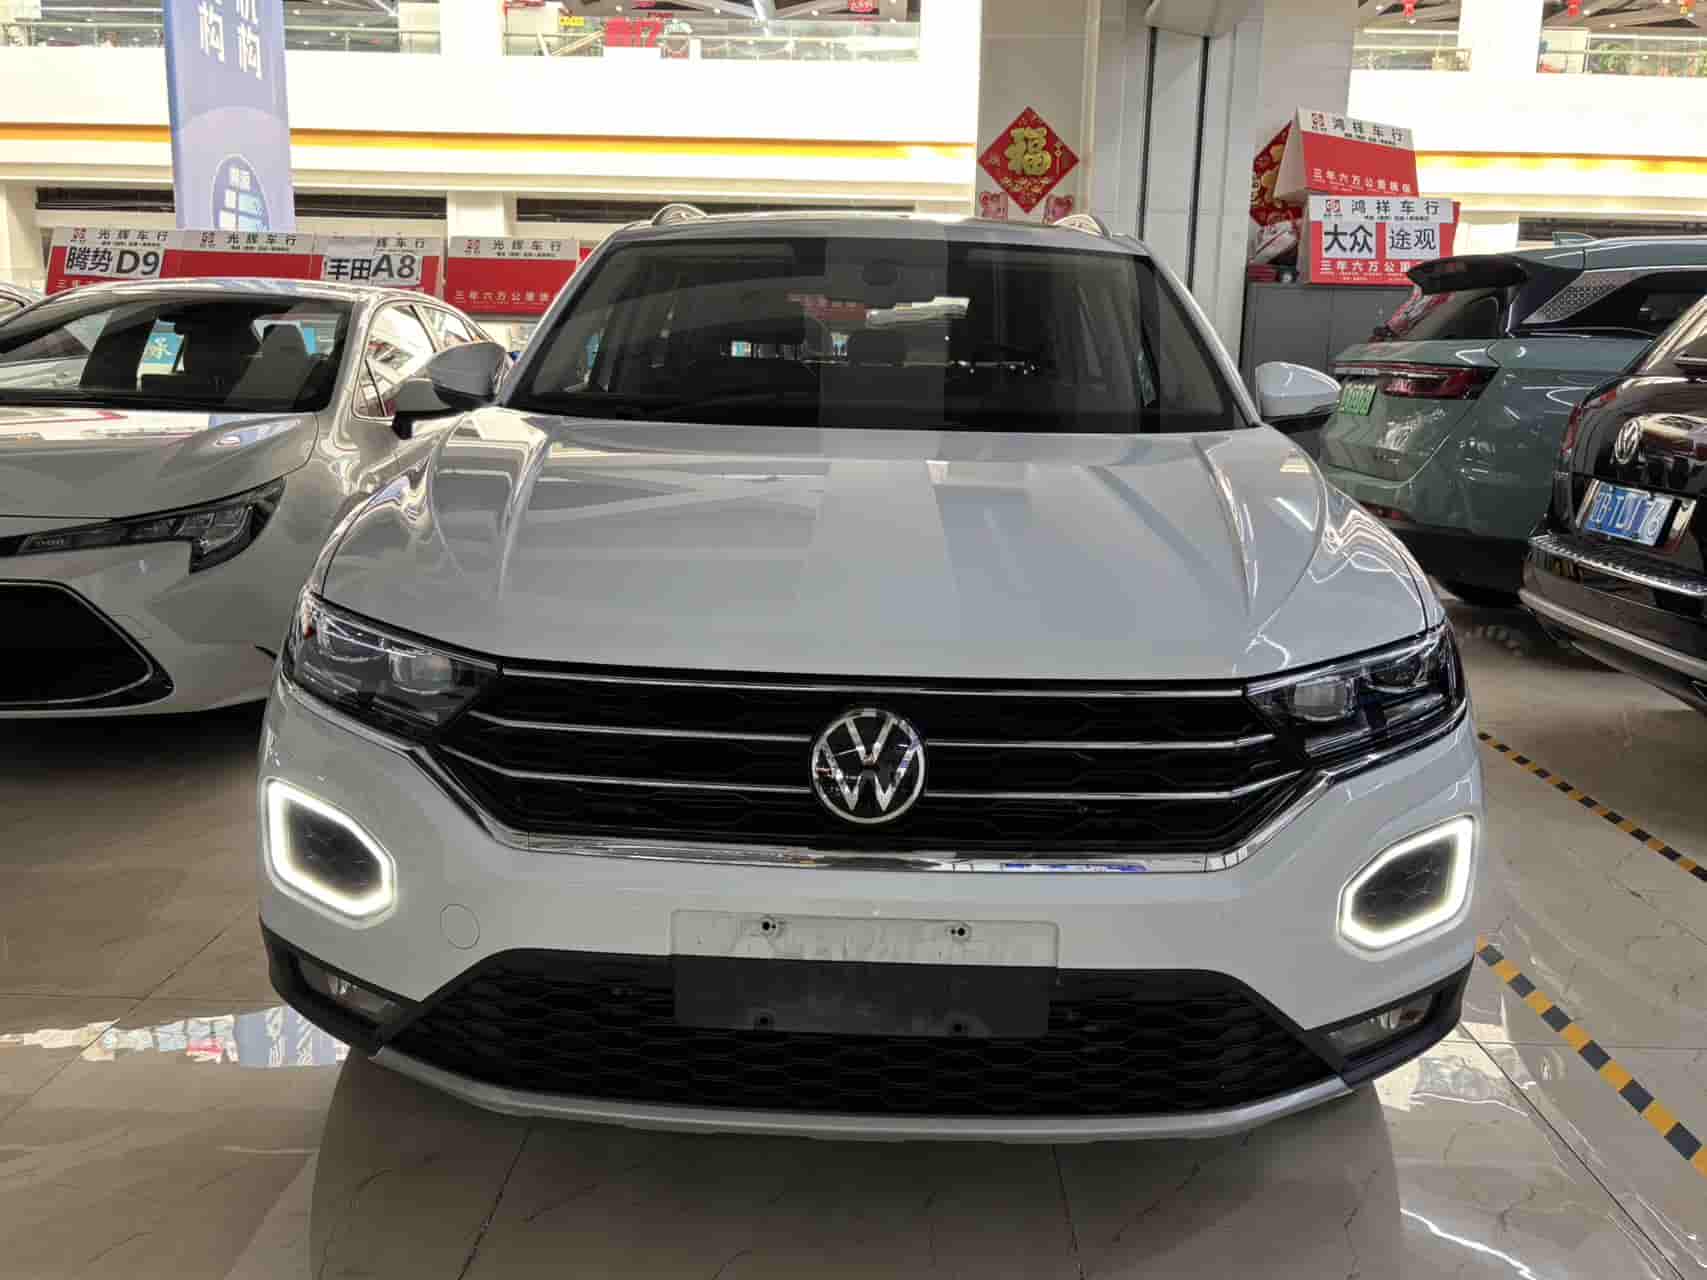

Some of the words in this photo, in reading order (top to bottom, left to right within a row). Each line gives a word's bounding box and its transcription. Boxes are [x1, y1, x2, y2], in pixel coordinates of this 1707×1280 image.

[1004, 128, 1051, 176] 福
[1352, 199, 1439, 215] 鸿祥车行
[1324, 223, 1373, 253] 大众
[1389, 228, 1437, 250] 途观
[814, 710, 923, 820] VW
